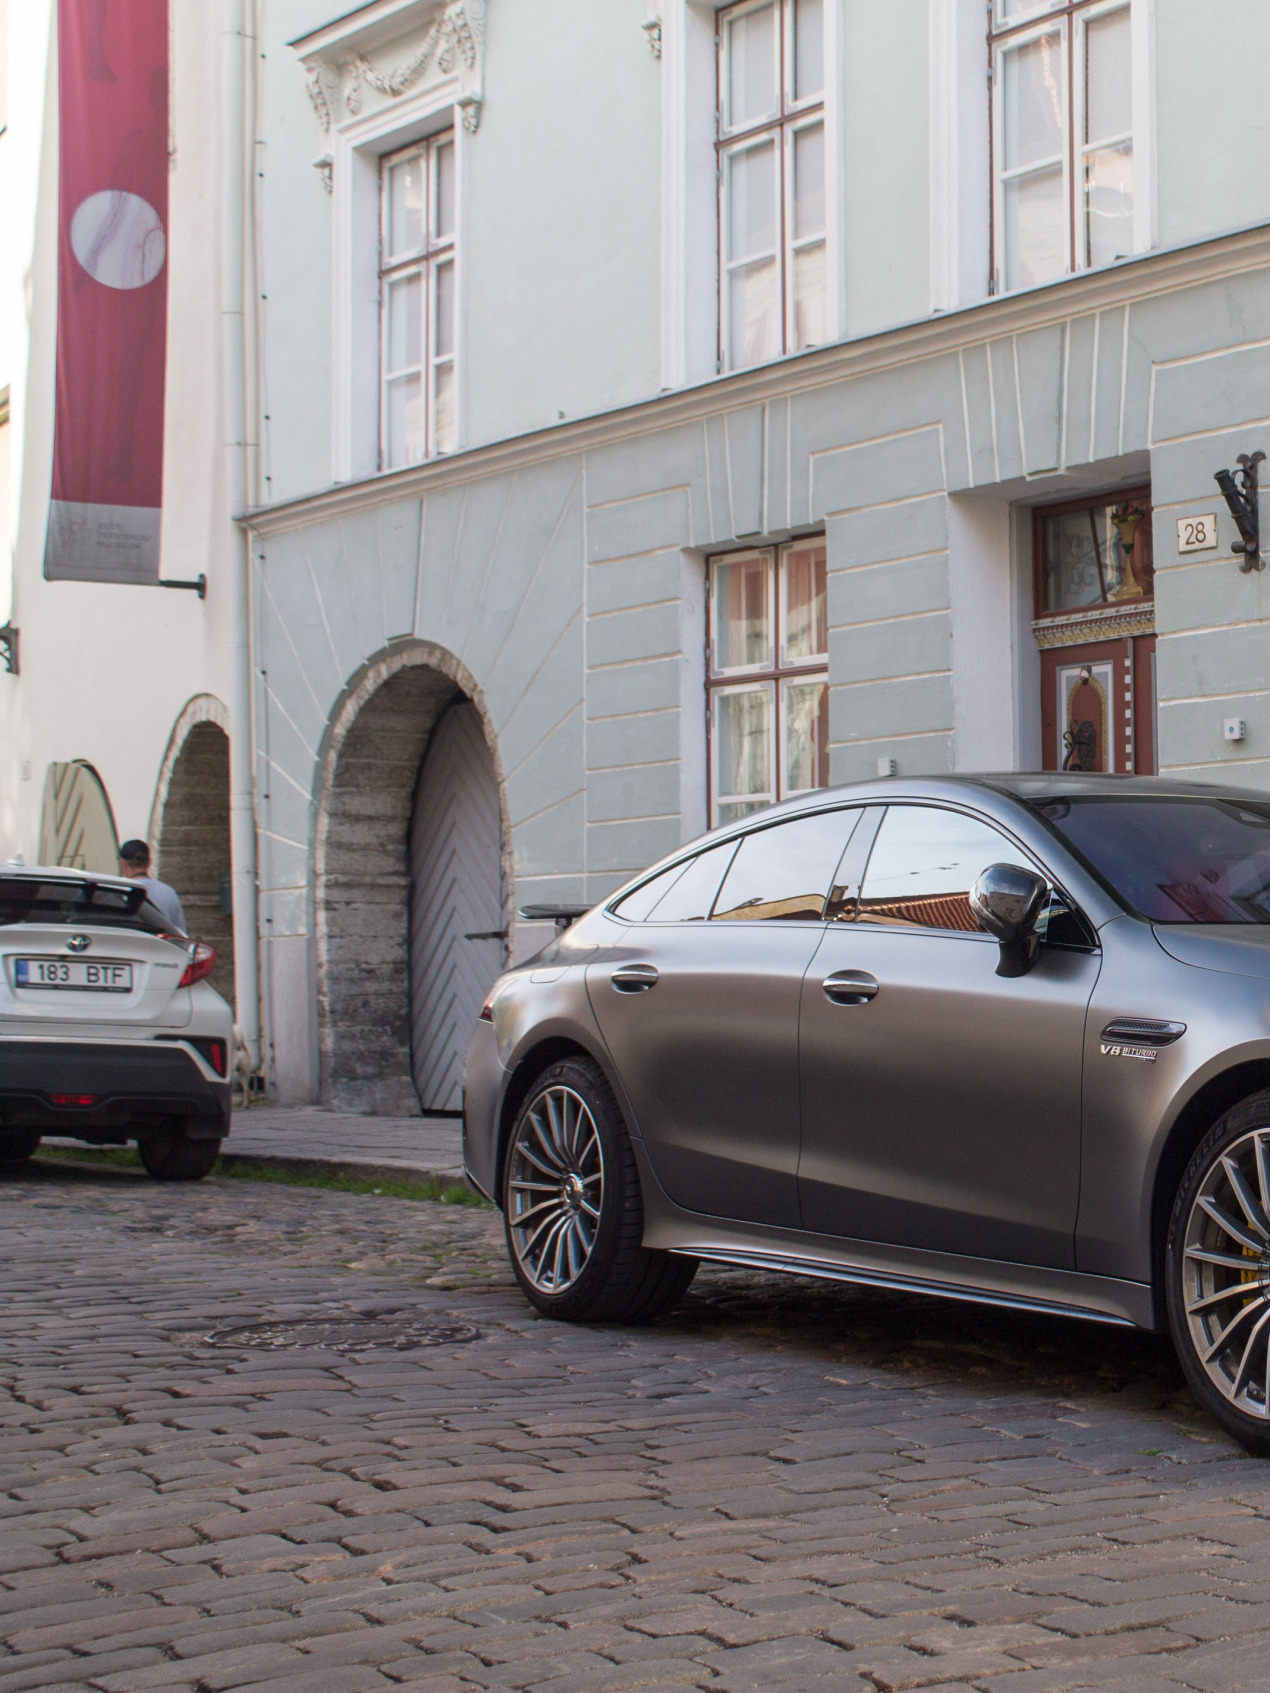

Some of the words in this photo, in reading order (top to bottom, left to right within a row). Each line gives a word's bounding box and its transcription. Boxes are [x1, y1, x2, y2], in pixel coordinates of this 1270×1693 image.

[1185, 522, 1206, 546] 28
[38, 963, 69, 982] 183
[86, 965, 126, 984] BTF
[1100, 1044, 1121, 1056] V8
[1122, 1047, 1157, 1058] BITURBO
